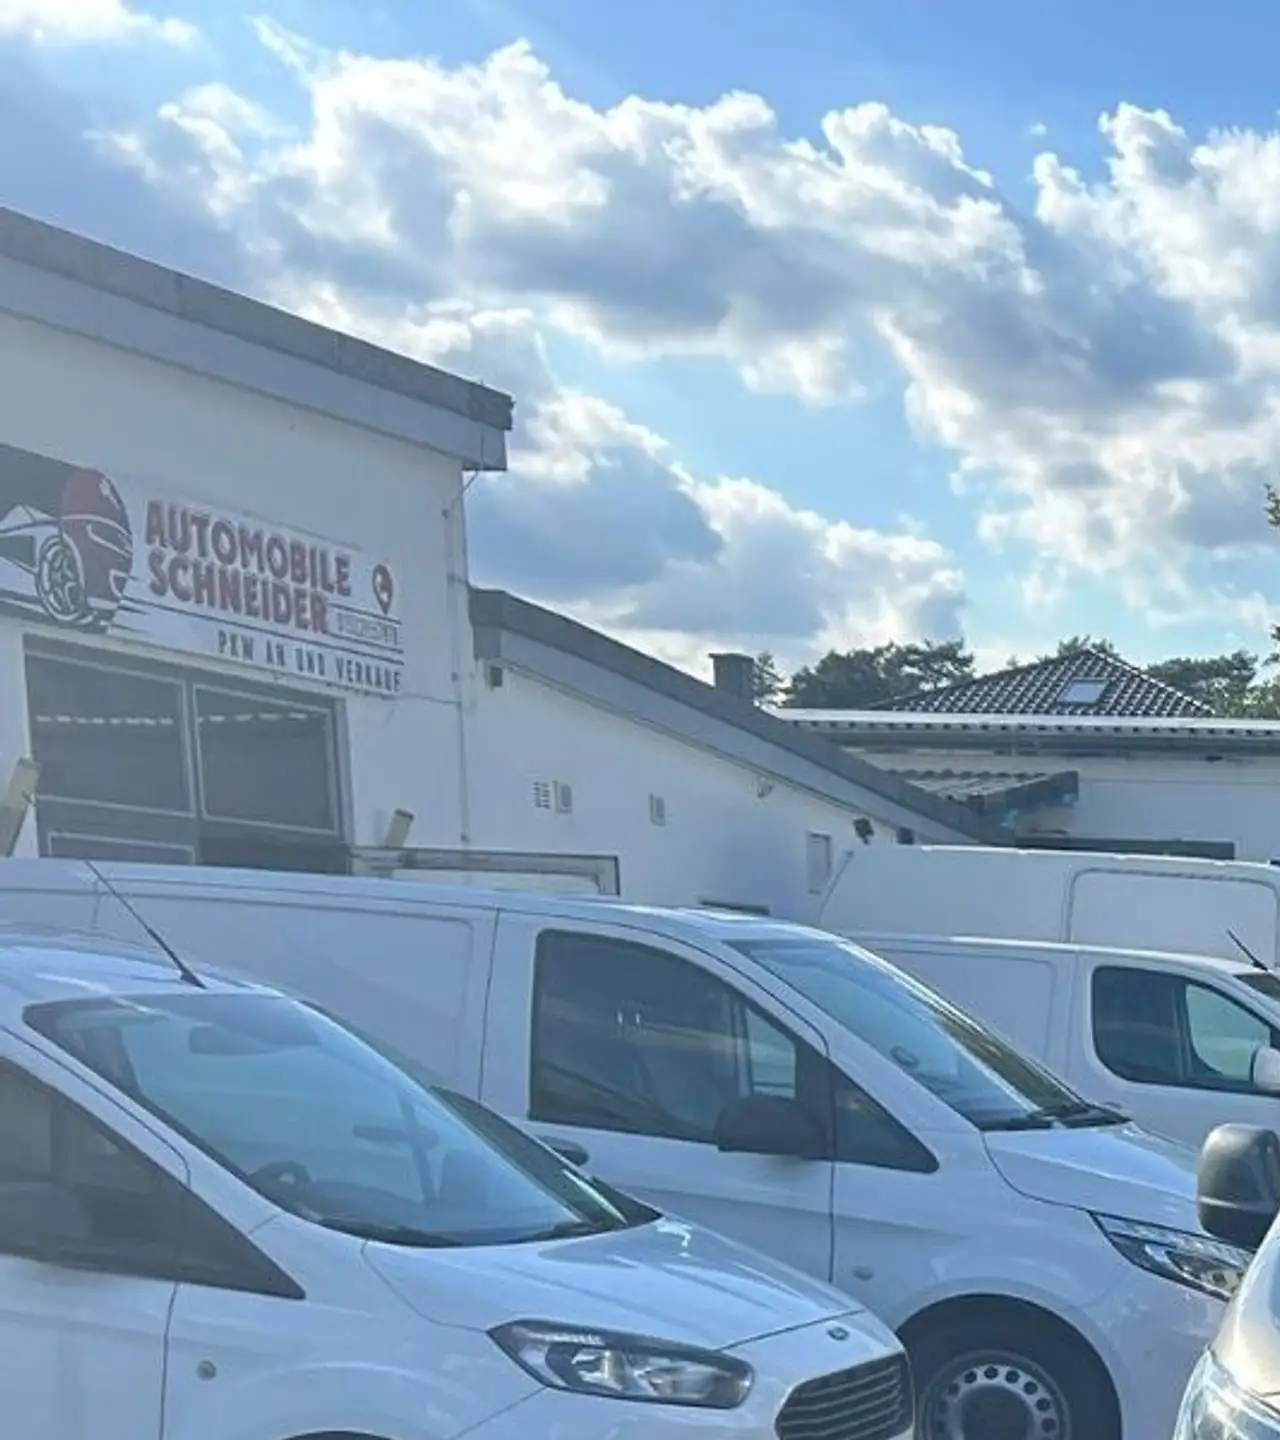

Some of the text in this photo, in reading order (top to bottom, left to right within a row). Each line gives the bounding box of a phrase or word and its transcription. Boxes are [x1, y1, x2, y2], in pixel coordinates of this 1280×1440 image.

[145, 499, 353, 598] AUTOMOBILE
[147, 548, 329, 634] SCHNEIDER
[217, 629, 254, 661] PKW
[293, 647, 326, 676] UND
